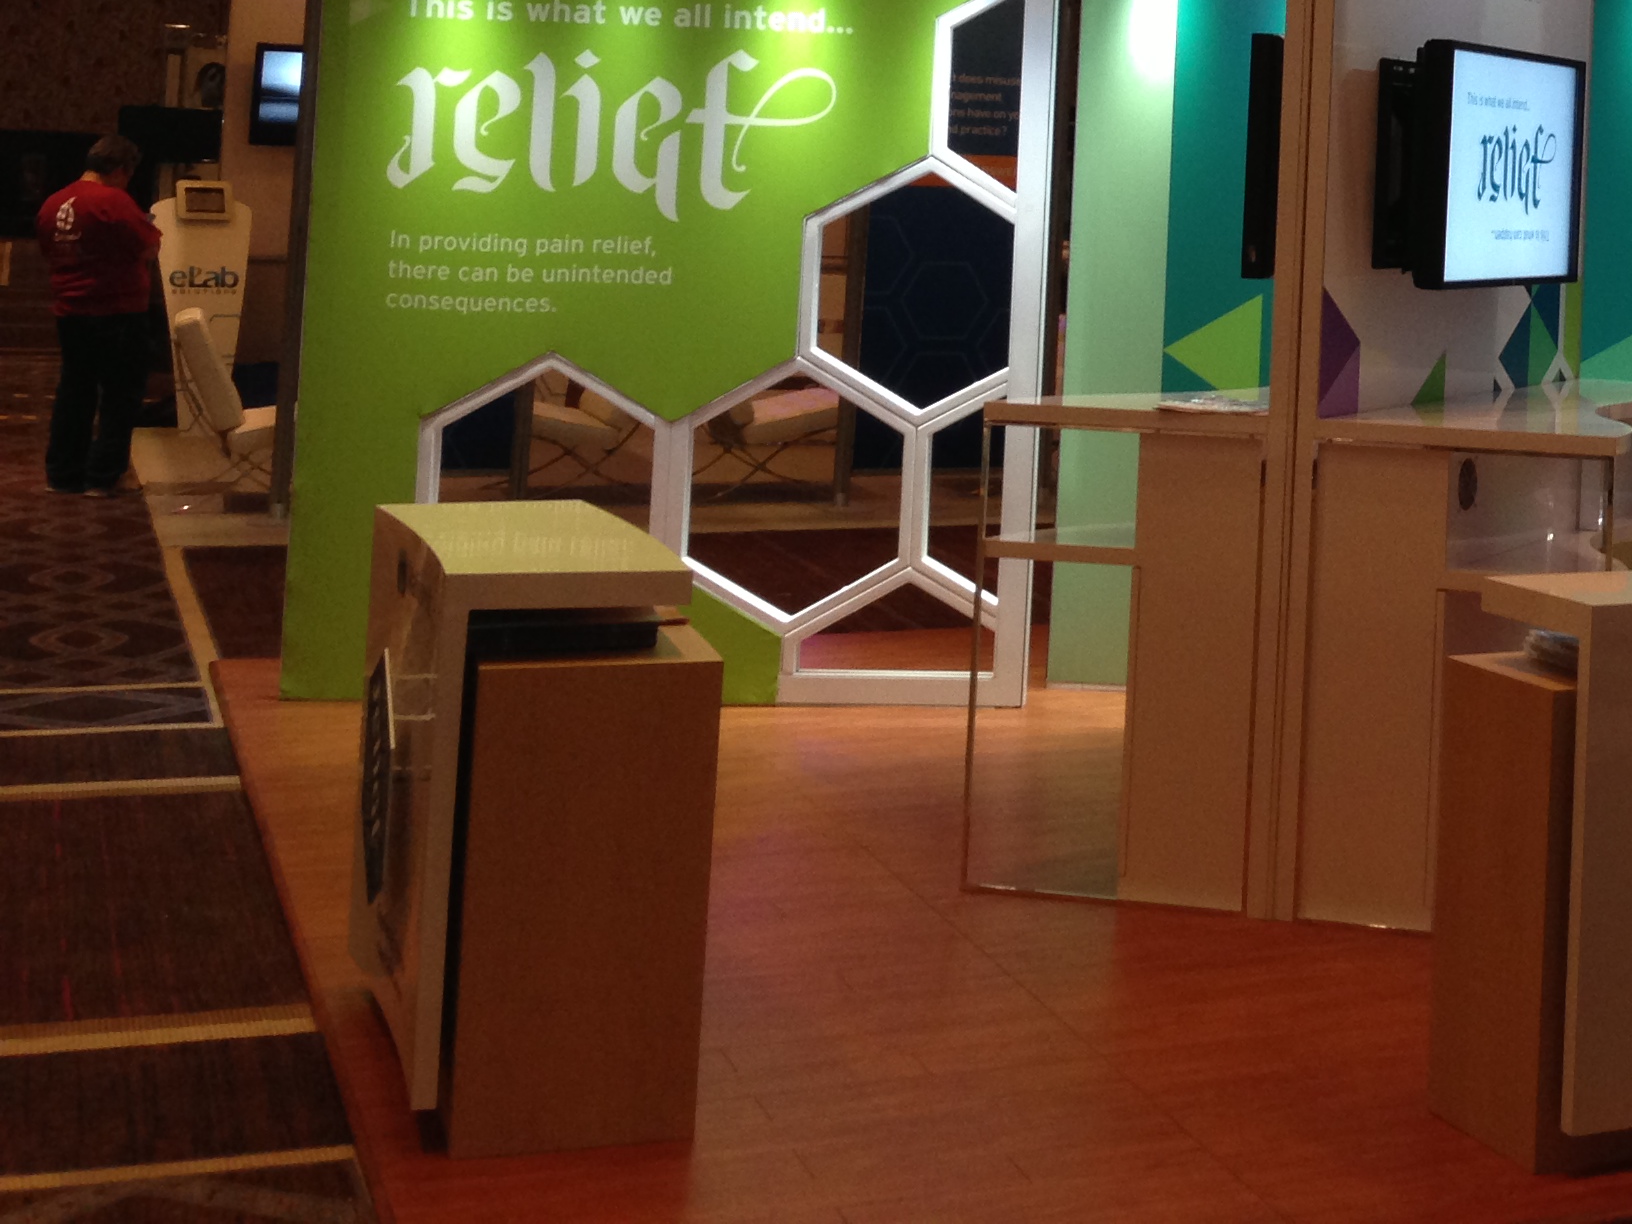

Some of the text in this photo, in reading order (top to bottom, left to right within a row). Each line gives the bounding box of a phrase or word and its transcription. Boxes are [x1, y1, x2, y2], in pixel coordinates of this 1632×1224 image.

[619, 3, 663, 27] we
[673, 3, 713, 29] all
[723, 3, 855, 35] intend...
[386, 48, 838, 223] relief
[1477, 123, 1557, 216] relief
[389, 229, 657, 258] In providing pain relief,
[169, 266, 239, 288] eLab
[388, 260, 674, 287] there can be unintended
[386, 291, 558, 316] consequences.
